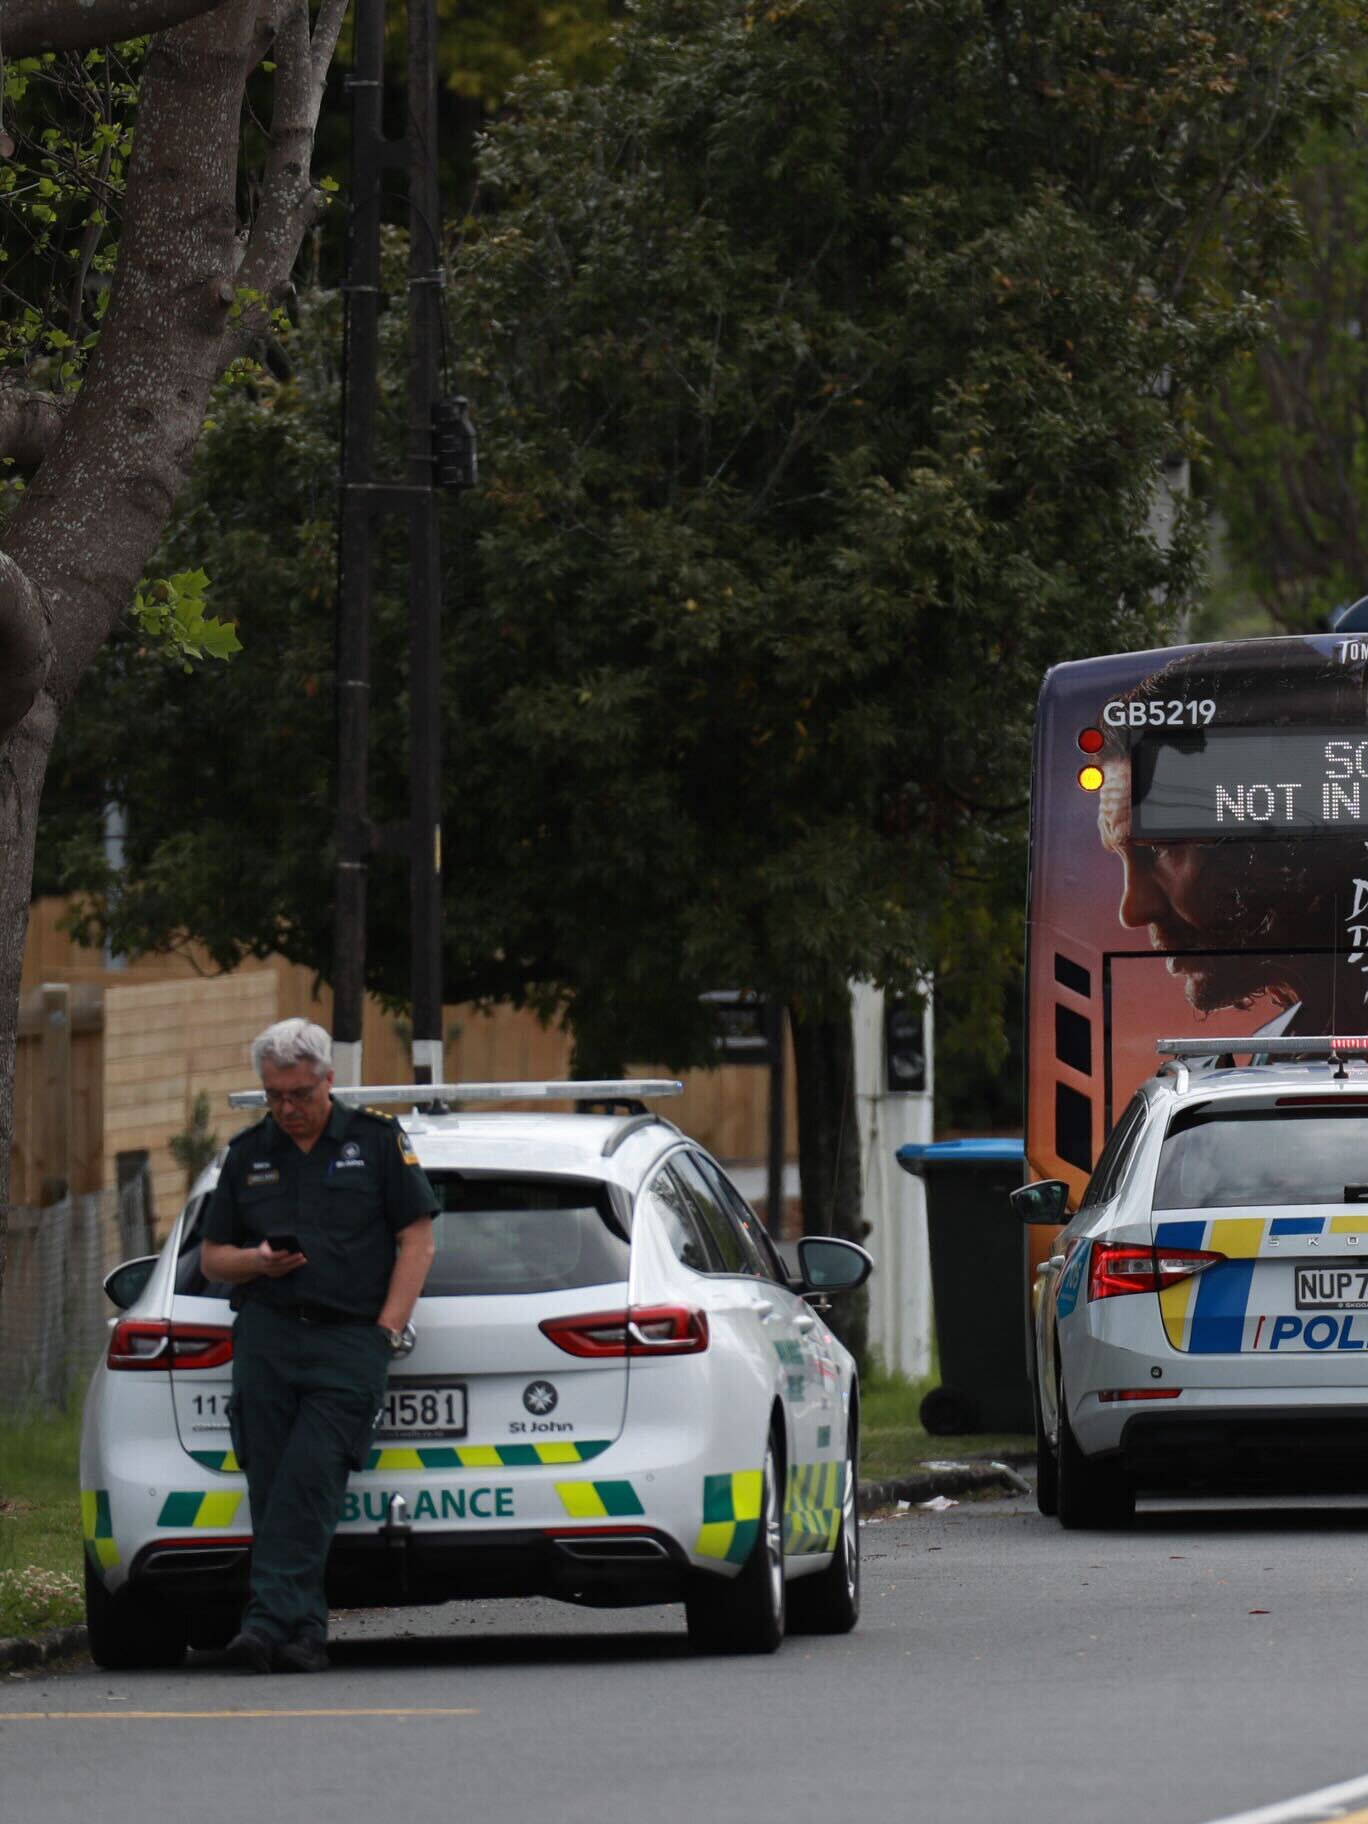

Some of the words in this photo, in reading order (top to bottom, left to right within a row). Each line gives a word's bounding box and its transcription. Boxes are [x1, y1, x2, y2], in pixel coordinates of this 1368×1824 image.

[1103, 699, 1216, 727] GB5219
[1216, 783, 1302, 821] NOT
[1322, 781, 1360, 820] IN
[509, 1422, 526, 1434] St
[531, 1421, 574, 1432] John
[341, 1488, 515, 1521] BUANCE
